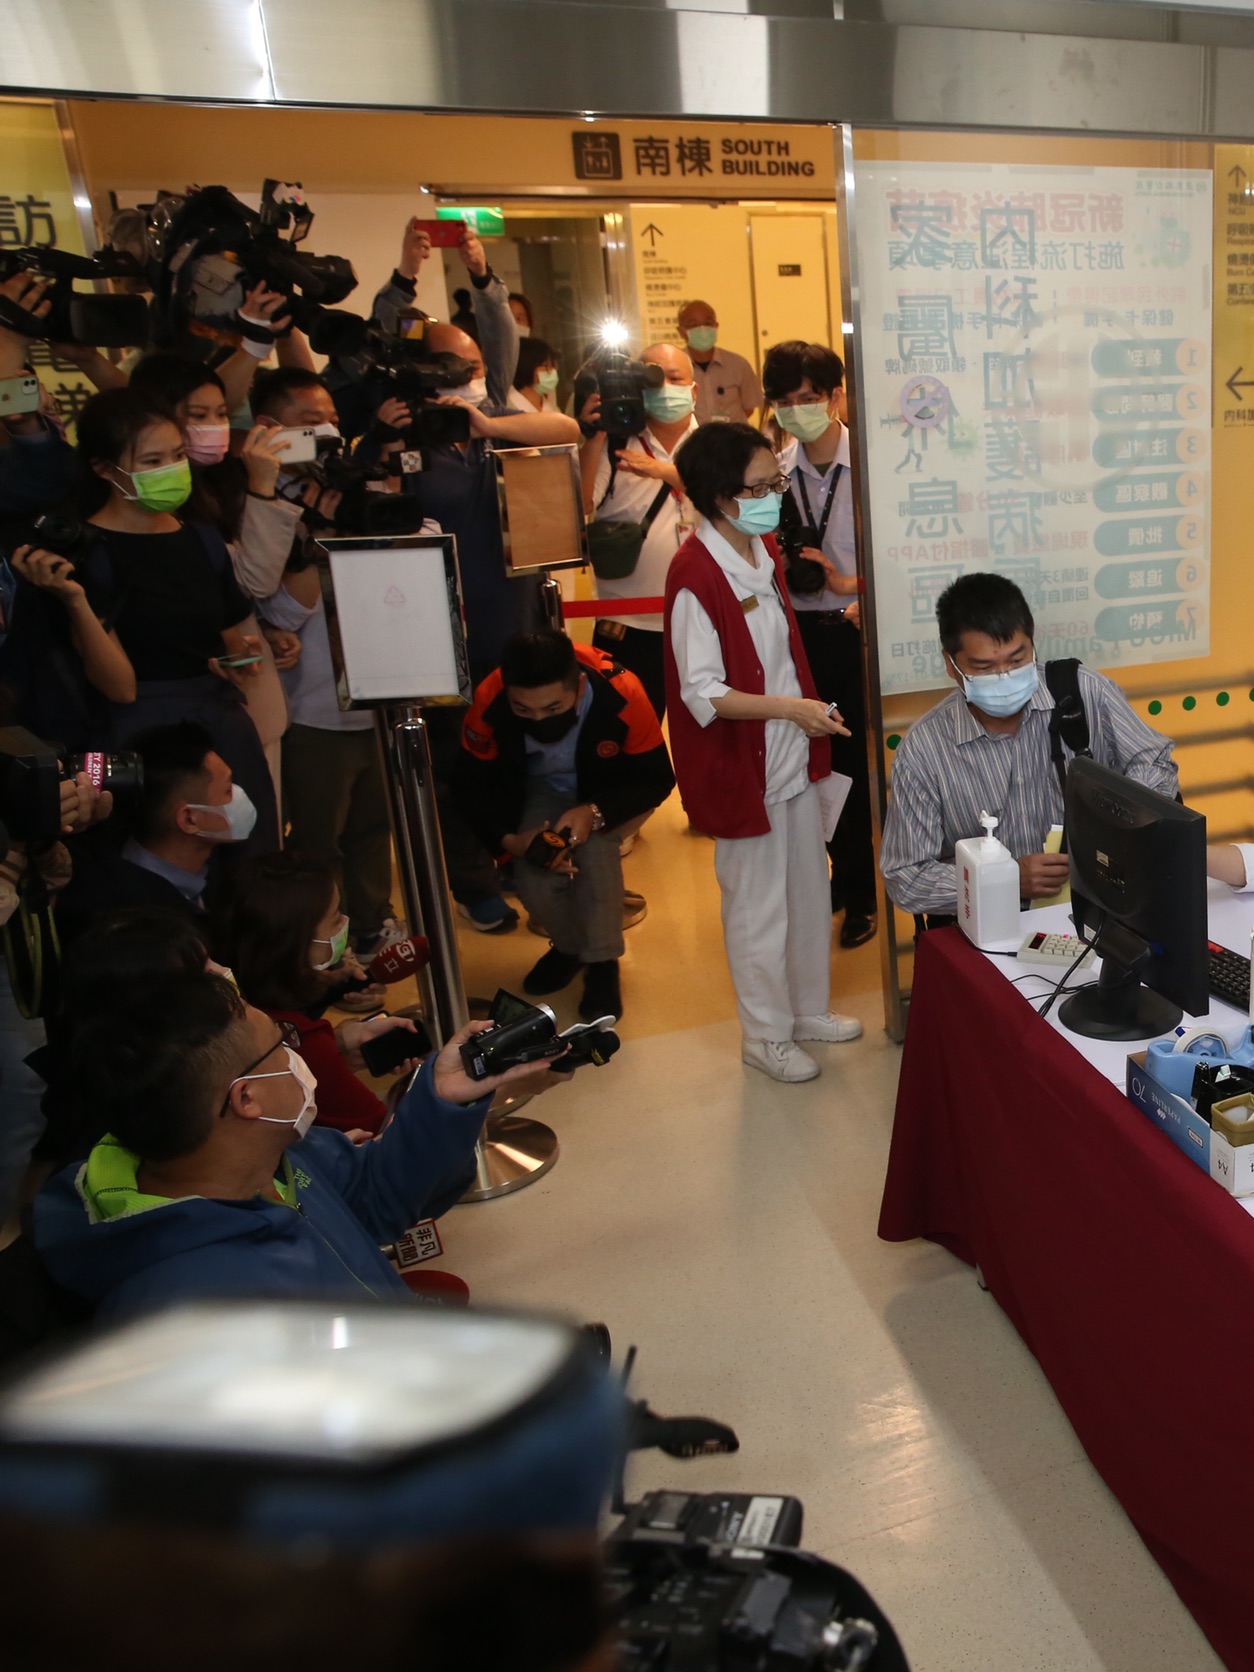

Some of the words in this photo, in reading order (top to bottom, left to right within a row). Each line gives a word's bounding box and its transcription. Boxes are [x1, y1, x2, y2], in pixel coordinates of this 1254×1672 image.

[632, 136, 713, 177] 南棟
[721, 139, 790, 156] SOUTH
[721, 159, 815, 177] BUILDING
[1150, 1091, 1181, 1125] PAPERLINE
[1217, 1158, 1230, 1176] A4
[416, 1225, 438, 1256] 非凡
